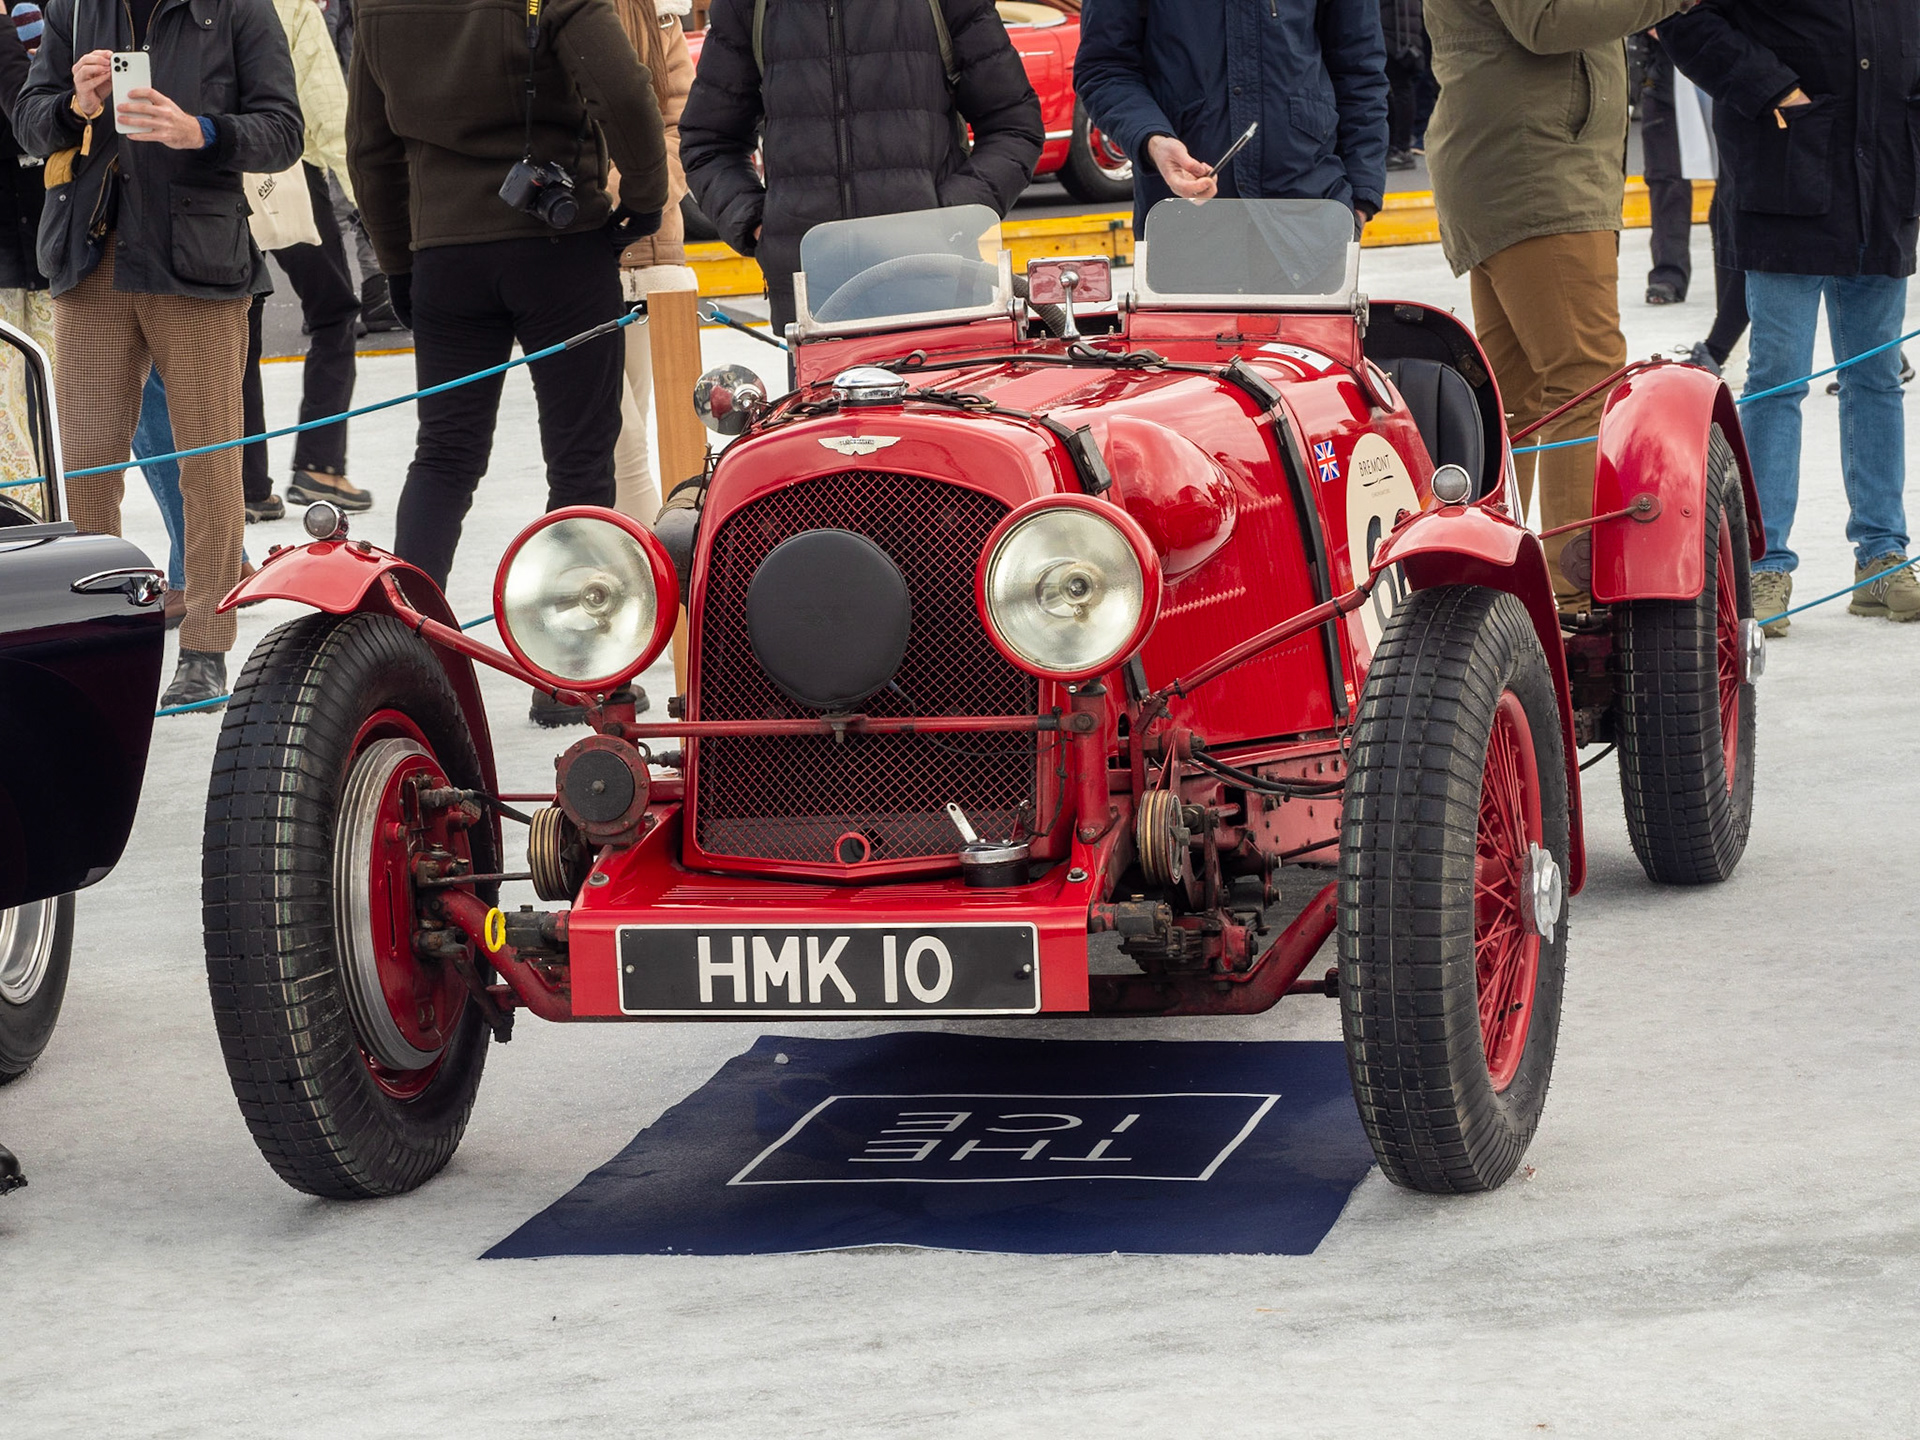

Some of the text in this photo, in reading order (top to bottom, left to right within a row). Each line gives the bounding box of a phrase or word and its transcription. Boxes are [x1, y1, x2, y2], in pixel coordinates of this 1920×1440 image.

[1359, 454, 1391, 477] BREMONT
[697, 935, 954, 1004] HMK 10
[880, 1111, 1141, 1134] ICE
[847, 1139, 1133, 1162] THE
